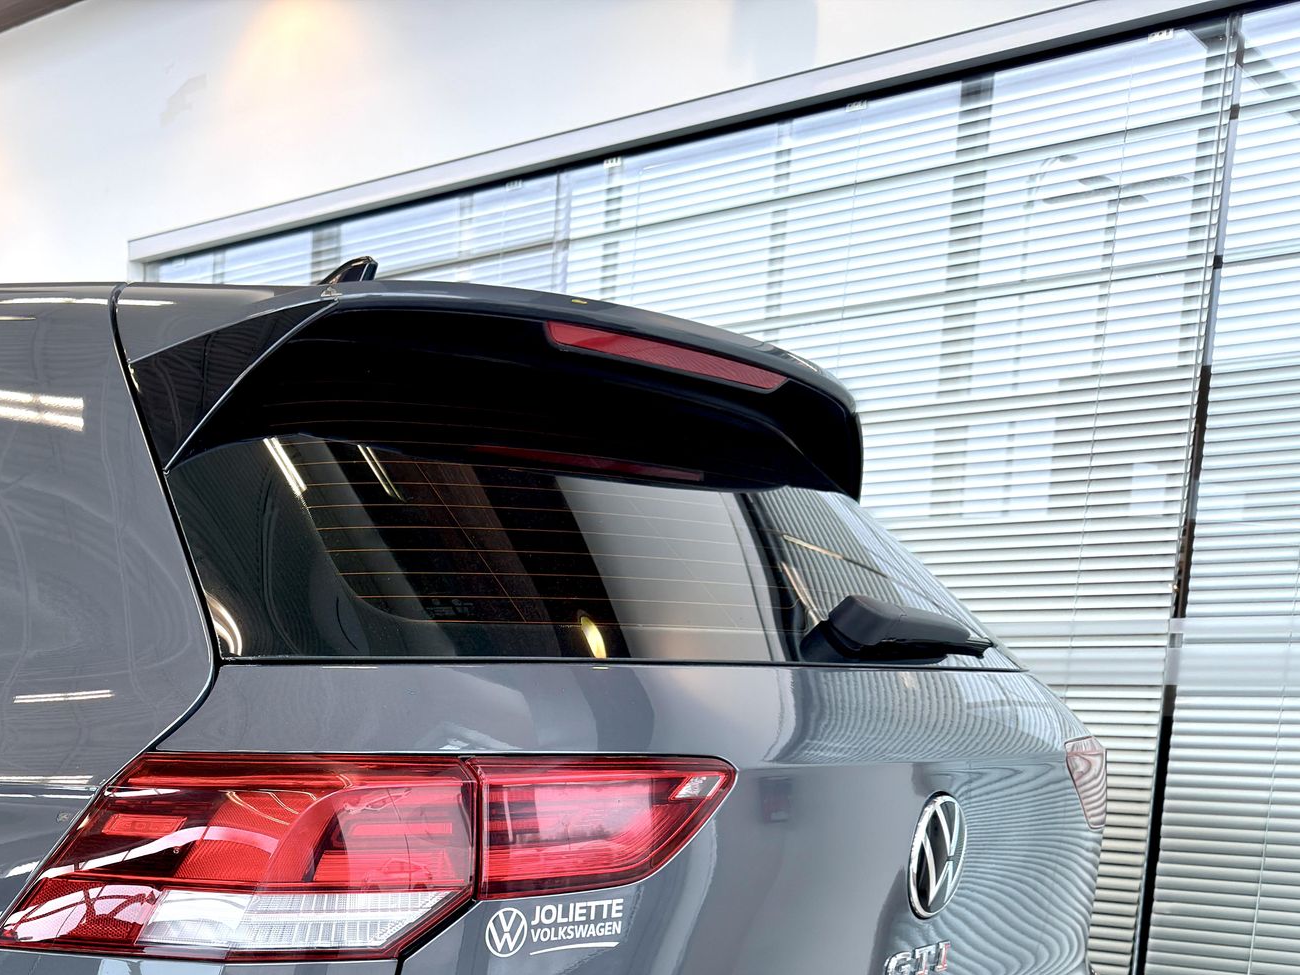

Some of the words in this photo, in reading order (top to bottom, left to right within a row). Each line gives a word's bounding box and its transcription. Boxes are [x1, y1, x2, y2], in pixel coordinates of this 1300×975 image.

[531, 898, 624, 926] JOLIETTE
[485, 907, 528, 958] VW
[530, 921, 622, 942] VOLKSWAGEN
